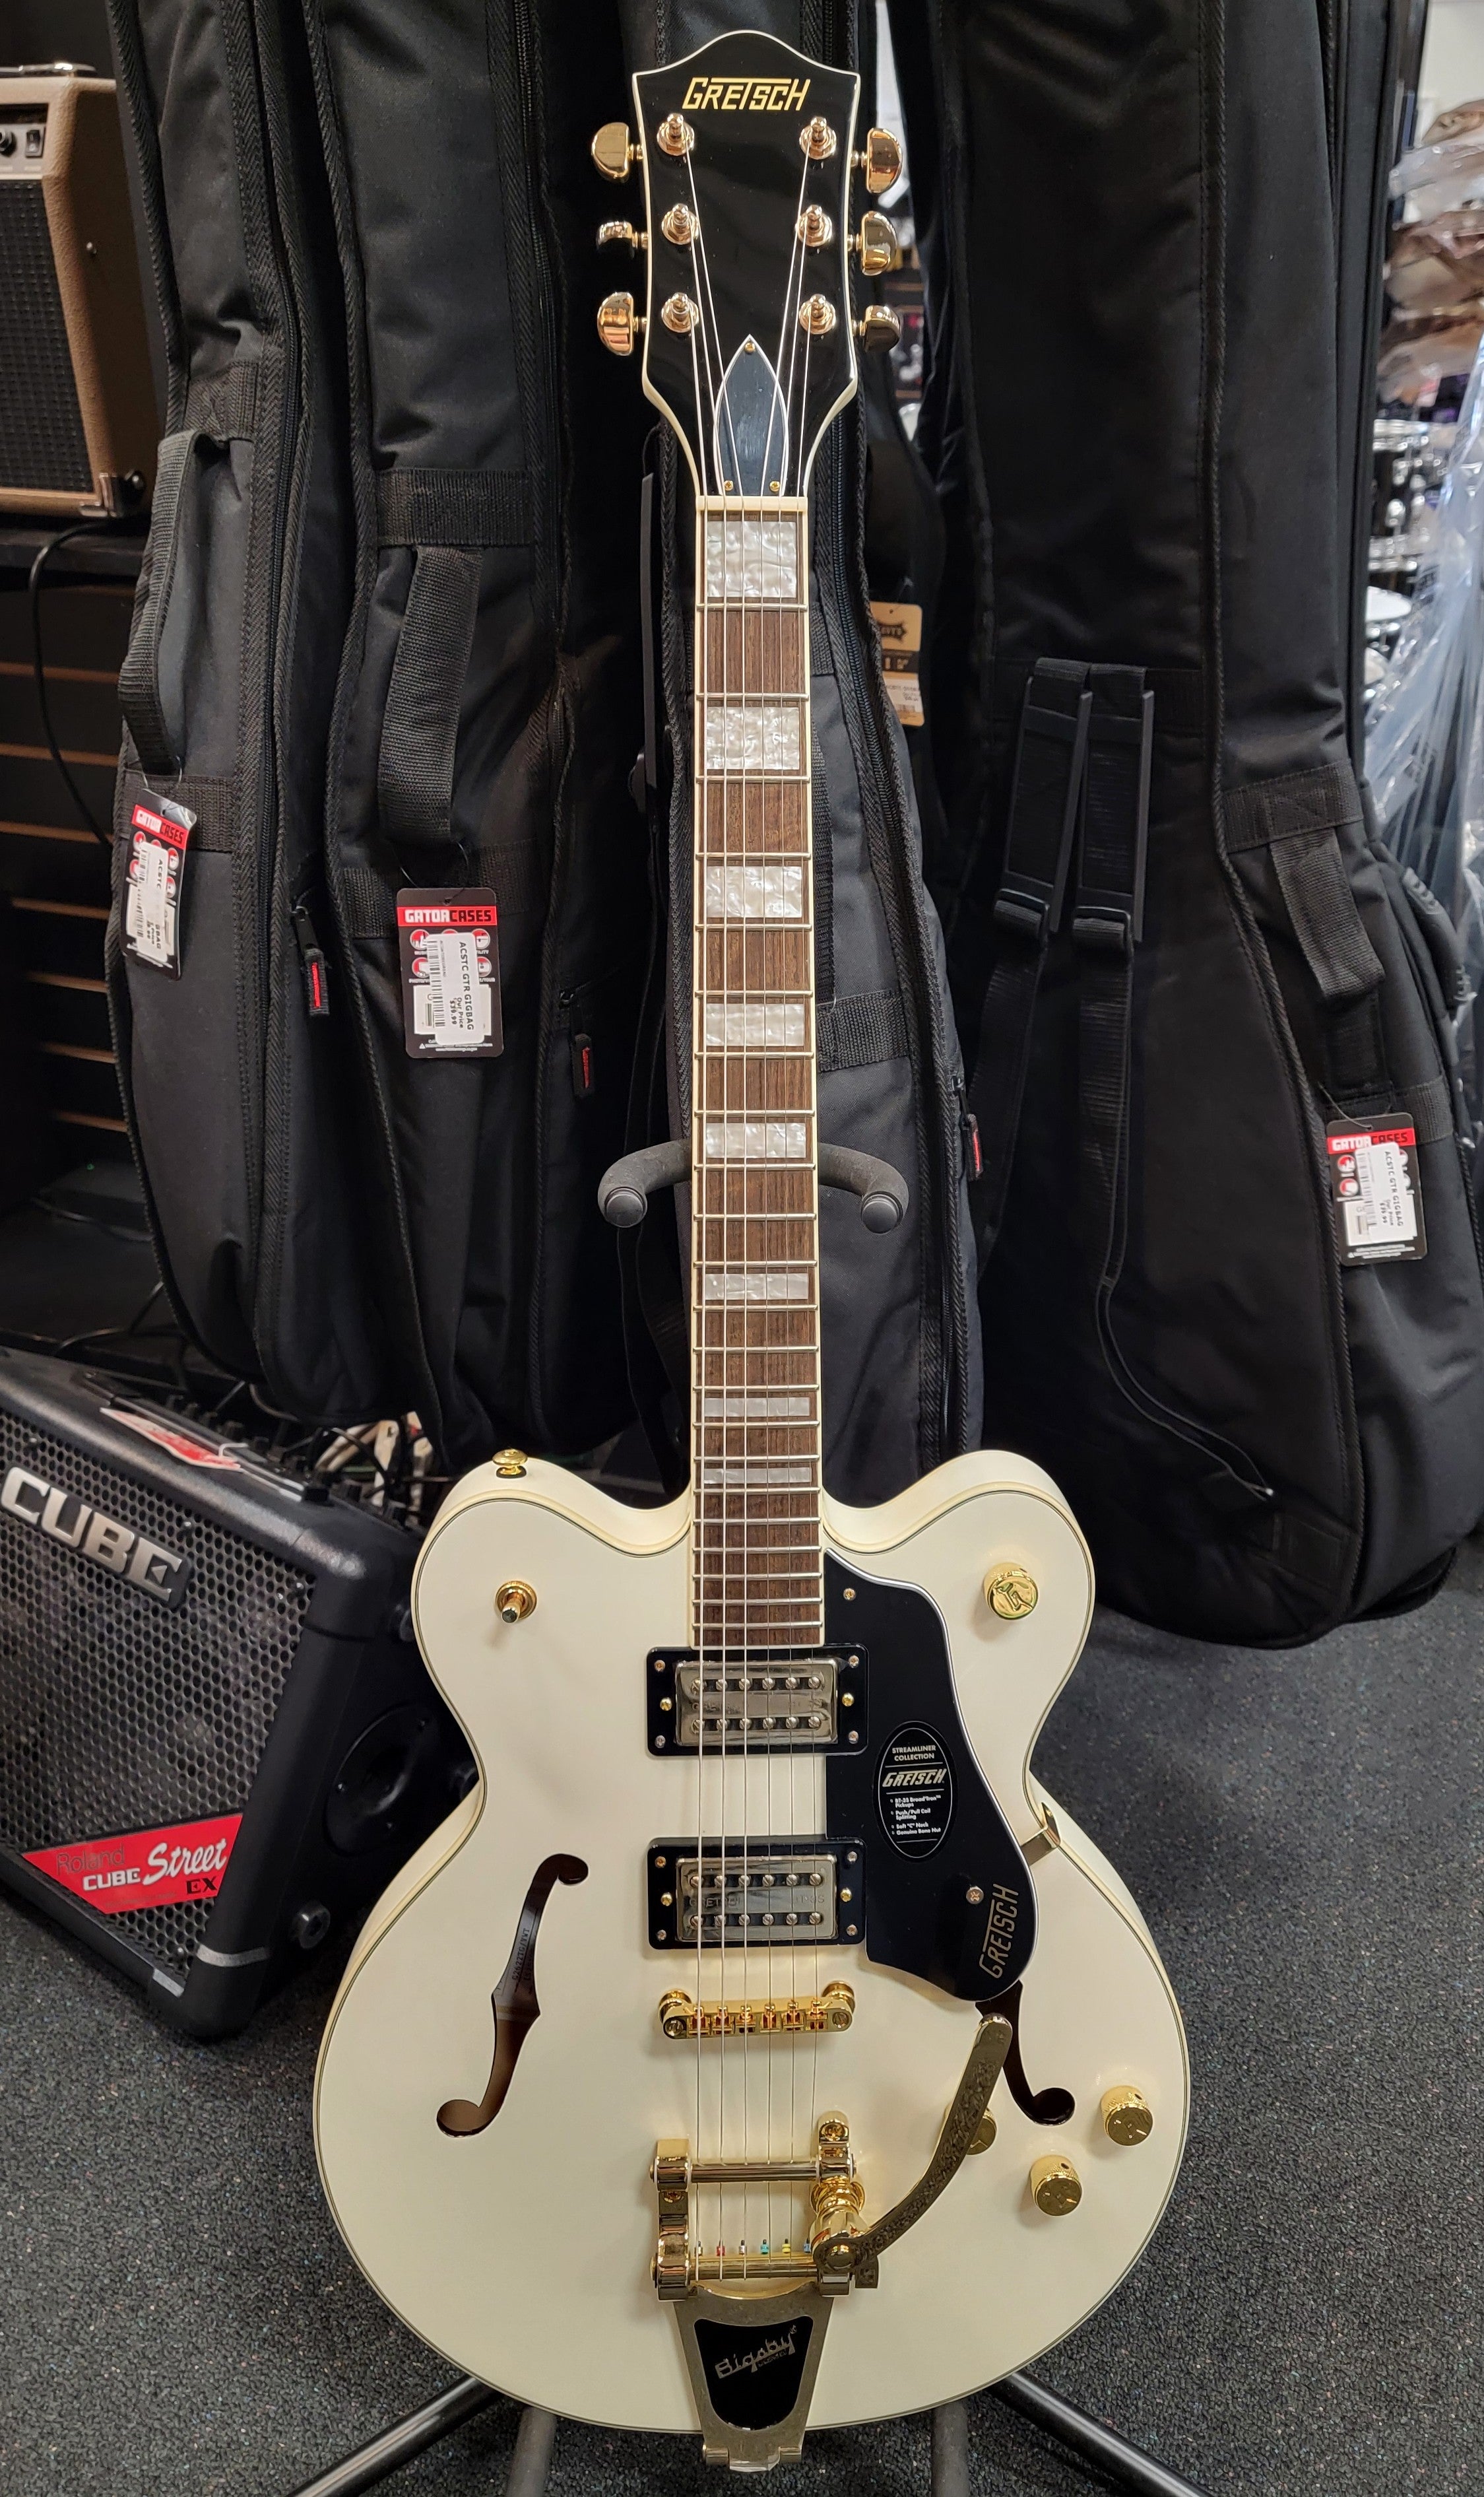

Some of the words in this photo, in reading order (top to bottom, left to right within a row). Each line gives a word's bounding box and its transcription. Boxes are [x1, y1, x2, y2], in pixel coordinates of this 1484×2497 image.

[682, 77, 810, 111] GRETSCH
[459, 942, 468, 971] ACSTC
[462, 974, 470, 991] GTR
[464, 994, 474, 1030] GIGBAG
[1384, 1151, 1395, 1176] ACSTC
[1392, 1195, 1403, 1226] GIGBAG
[1, 1467, 182, 1601] CUBE
[892, 1745, 936, 1754] STREAMLINER
[882, 1769, 947, 1787] GRETSCH
[56, 1844, 125, 1875] Roland
[83, 1868, 141, 1891] CUBE
[143, 1838, 227, 1886] Street
[187, 1877, 218, 1894] EX
[979, 1883, 1019, 1979] GRETSCH
[715, 2331, 796, 2379] Bigsby
